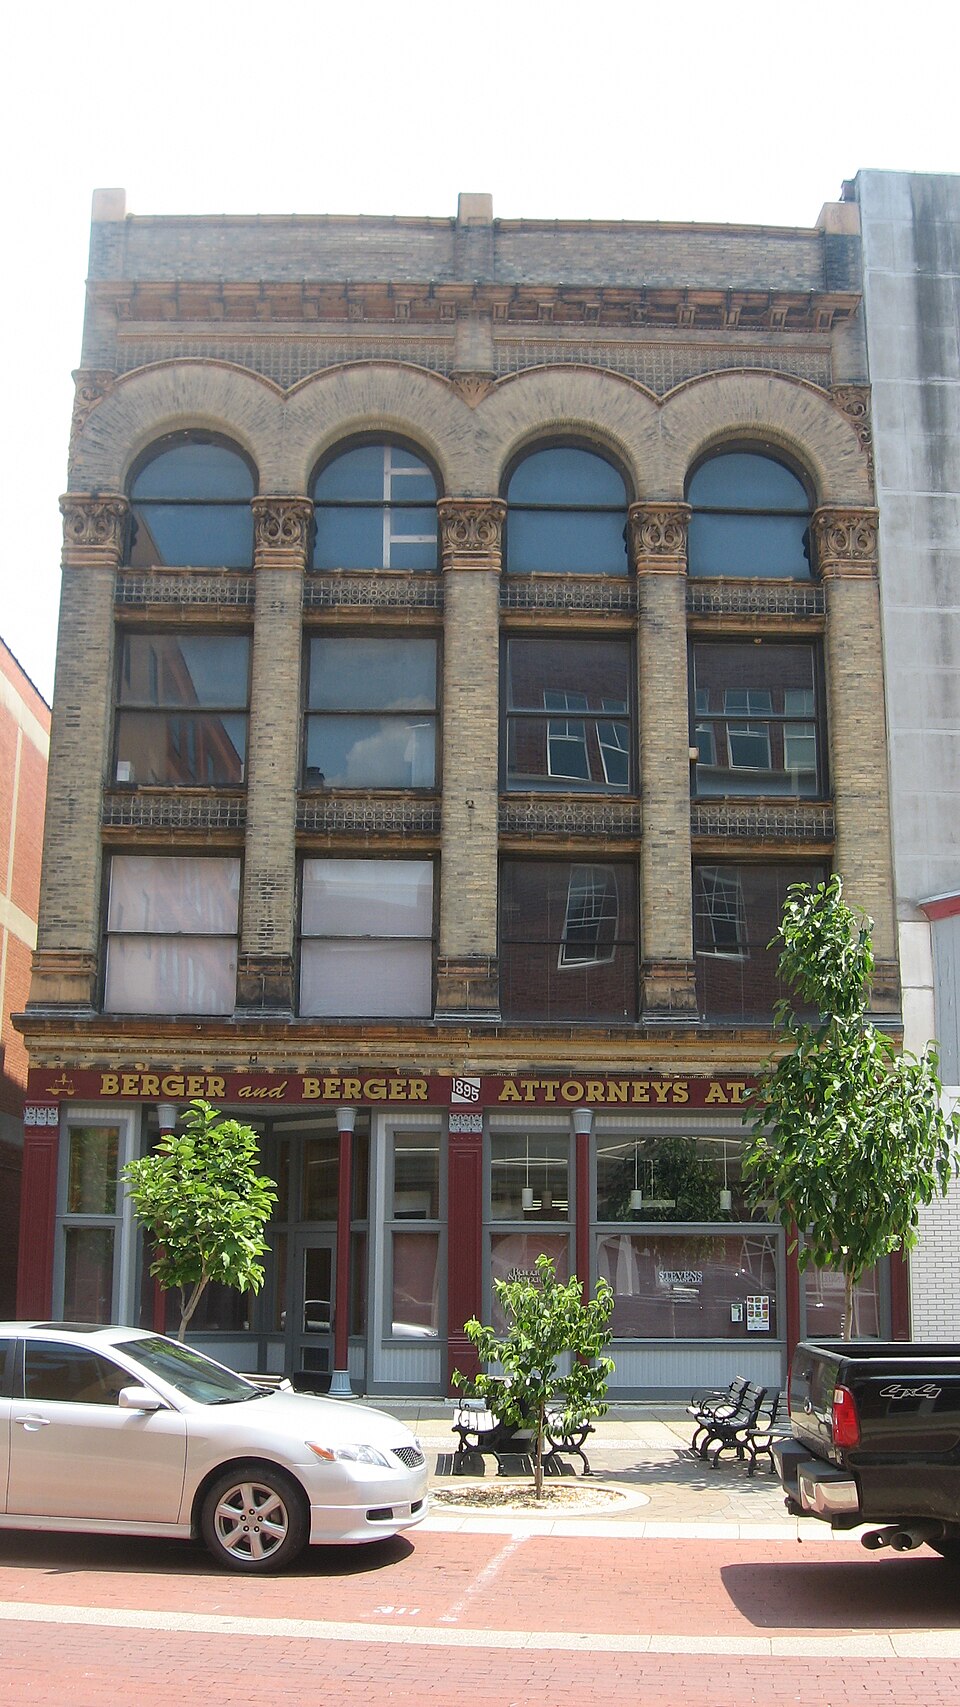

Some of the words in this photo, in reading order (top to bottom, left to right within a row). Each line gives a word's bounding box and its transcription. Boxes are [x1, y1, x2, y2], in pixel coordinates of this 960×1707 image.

[100, 1074, 226, 1097] BERGER
[238, 1081, 288, 1098] and
[302, 1078, 428, 1100] BERGER
[452, 1077, 480, 1102] 1895
[498, 1080, 689, 1103] ATTORNEYS
[704, 1082, 746, 1104] AT
[659, 1270, 702, 1279] STEVENS
[879, 1383, 942, 1399] 4x4
